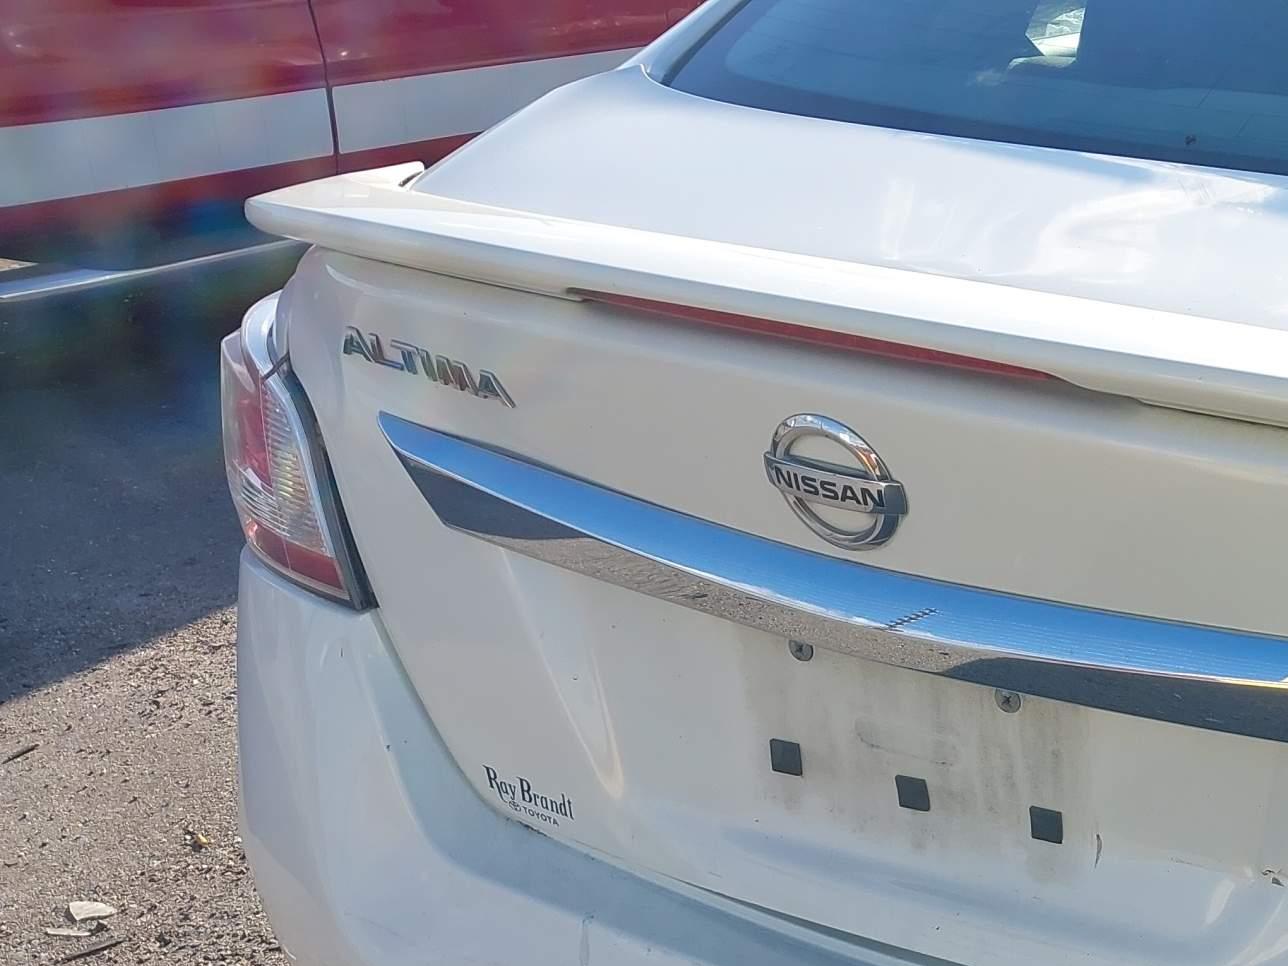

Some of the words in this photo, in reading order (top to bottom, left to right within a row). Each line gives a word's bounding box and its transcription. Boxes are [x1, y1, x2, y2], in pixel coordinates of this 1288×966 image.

[343, 325, 516, 409] ALTIMA
[773, 465, 885, 508] NISSAN
[481, 764, 516, 804] Ray
[516, 776, 575, 821] Brandt
[522, 805, 560, 827] TOYOTA
